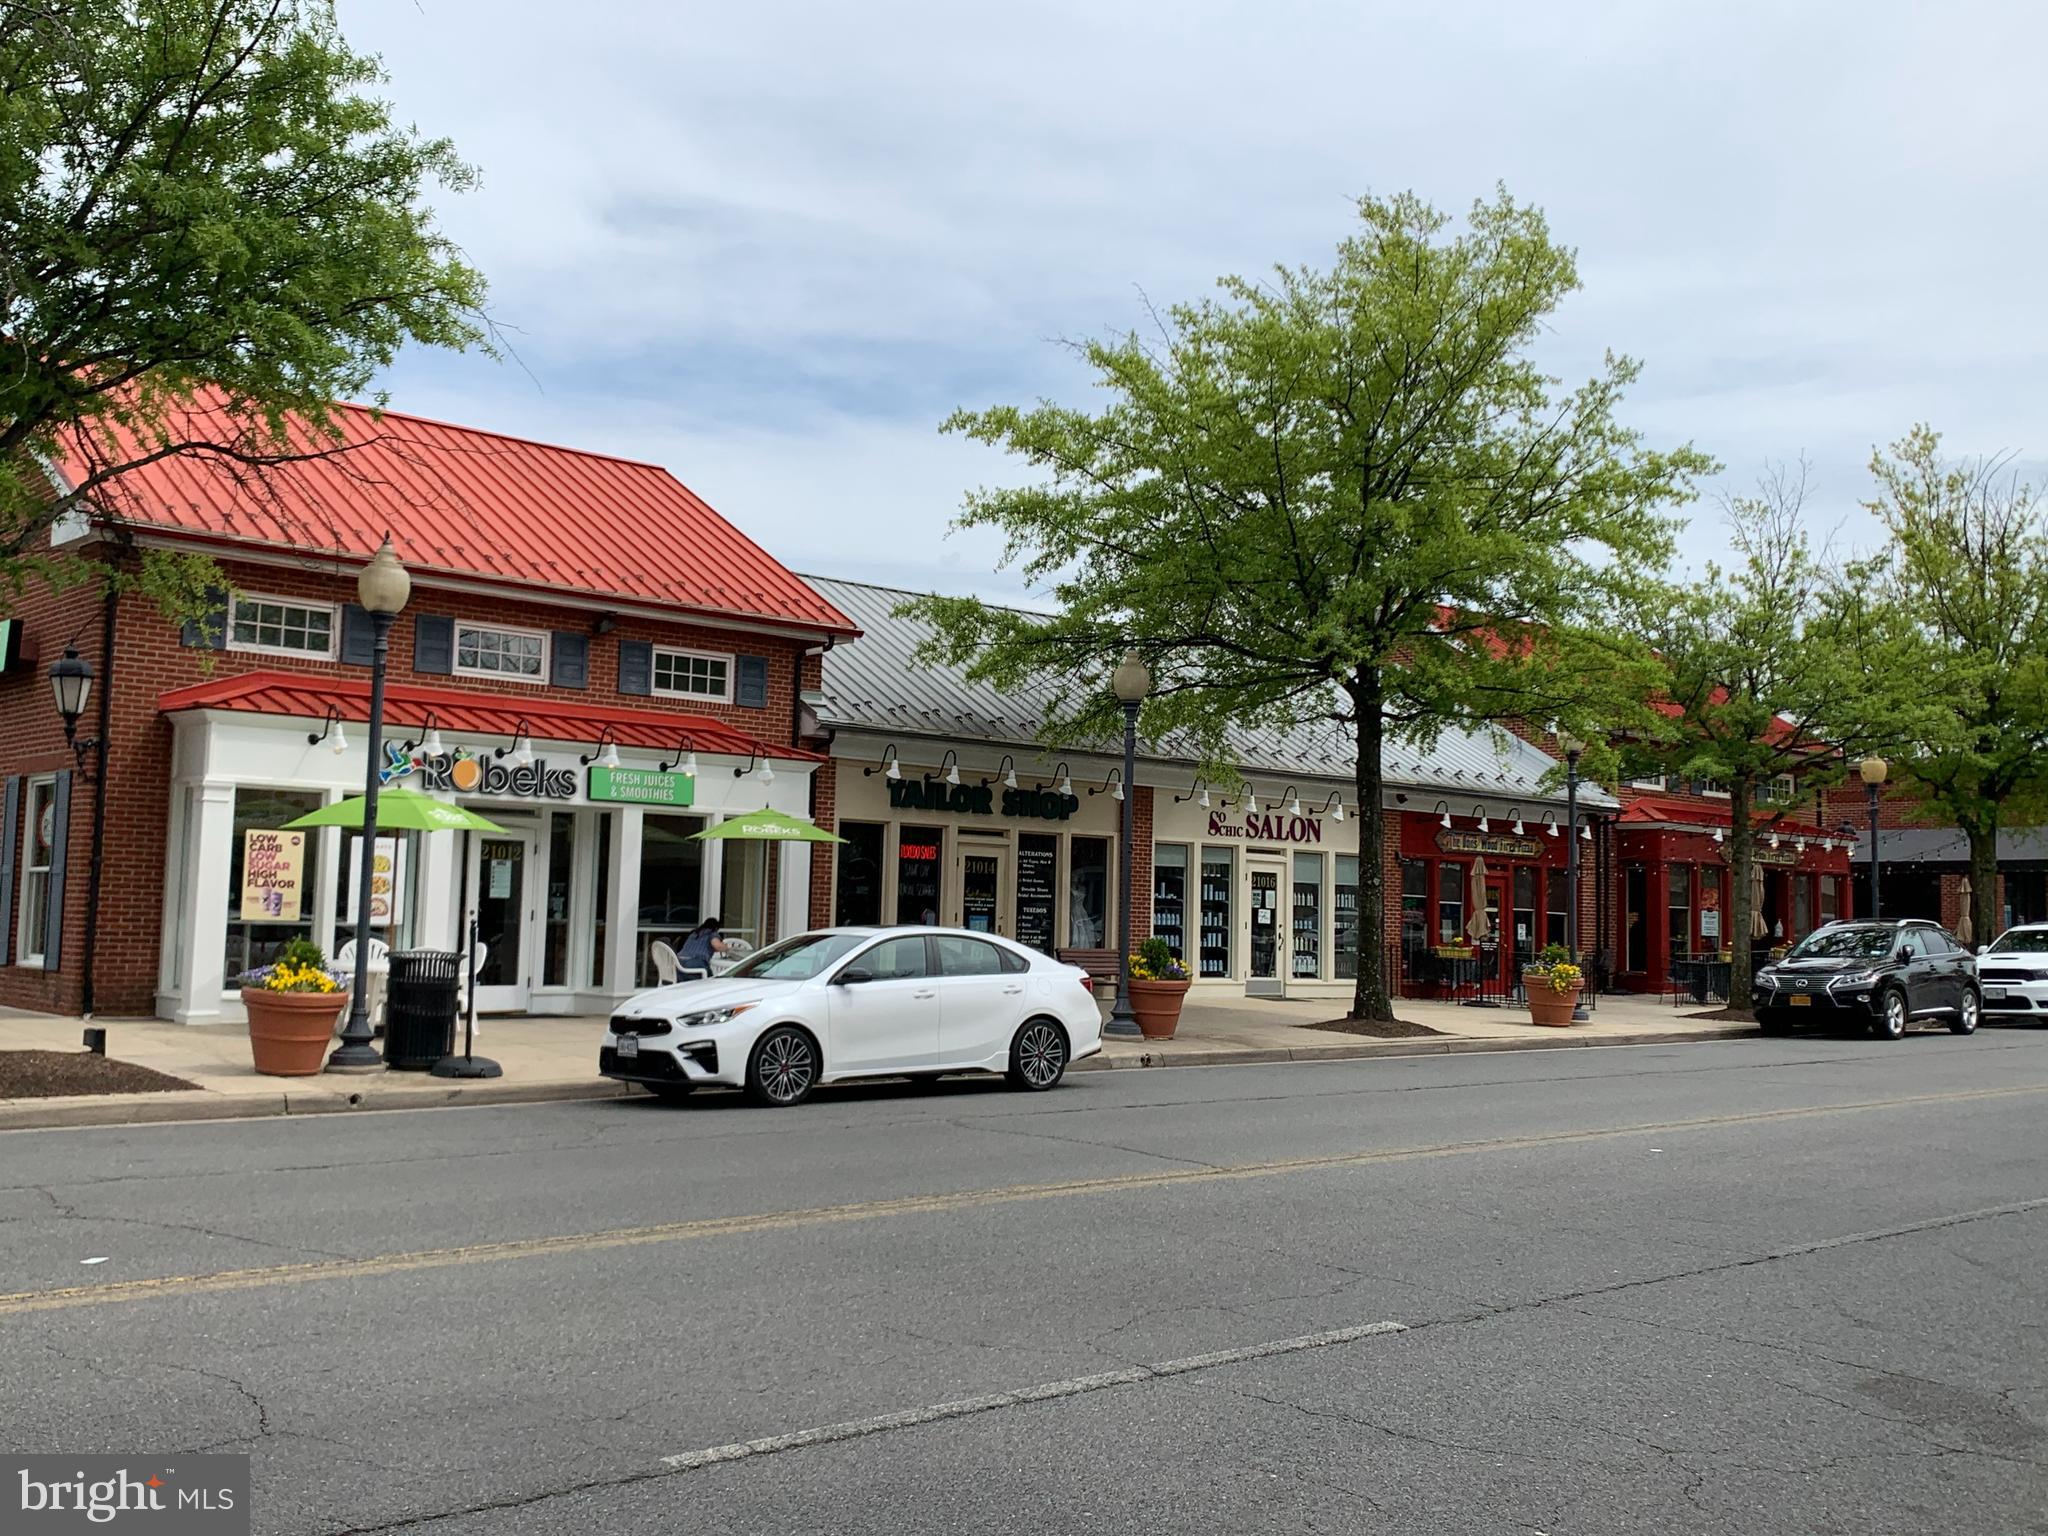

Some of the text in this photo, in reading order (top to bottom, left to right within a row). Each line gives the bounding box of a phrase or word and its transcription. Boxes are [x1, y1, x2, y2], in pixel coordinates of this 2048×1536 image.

[423, 749, 577, 799] Robeks
[610, 772, 675, 787] FRESH JUICES
[610, 786, 674, 800] & SMOOTHIES
[887, 778, 1079, 820] TAILOR SHOP
[1219, 814, 1322, 842] CHIC SALON
[249, 834, 278, 843] LOW
[249, 843, 283, 852] CARB
[481, 844, 522, 861] 21012
[249, 851, 277, 861] LOW
[248, 860, 290, 870] SUGAR
[965, 861, 995, 874] 21014
[248, 870, 277, 879] HIGH
[247, 879, 295, 888] FLAVOR
[1252, 876, 1276, 888] 21016
